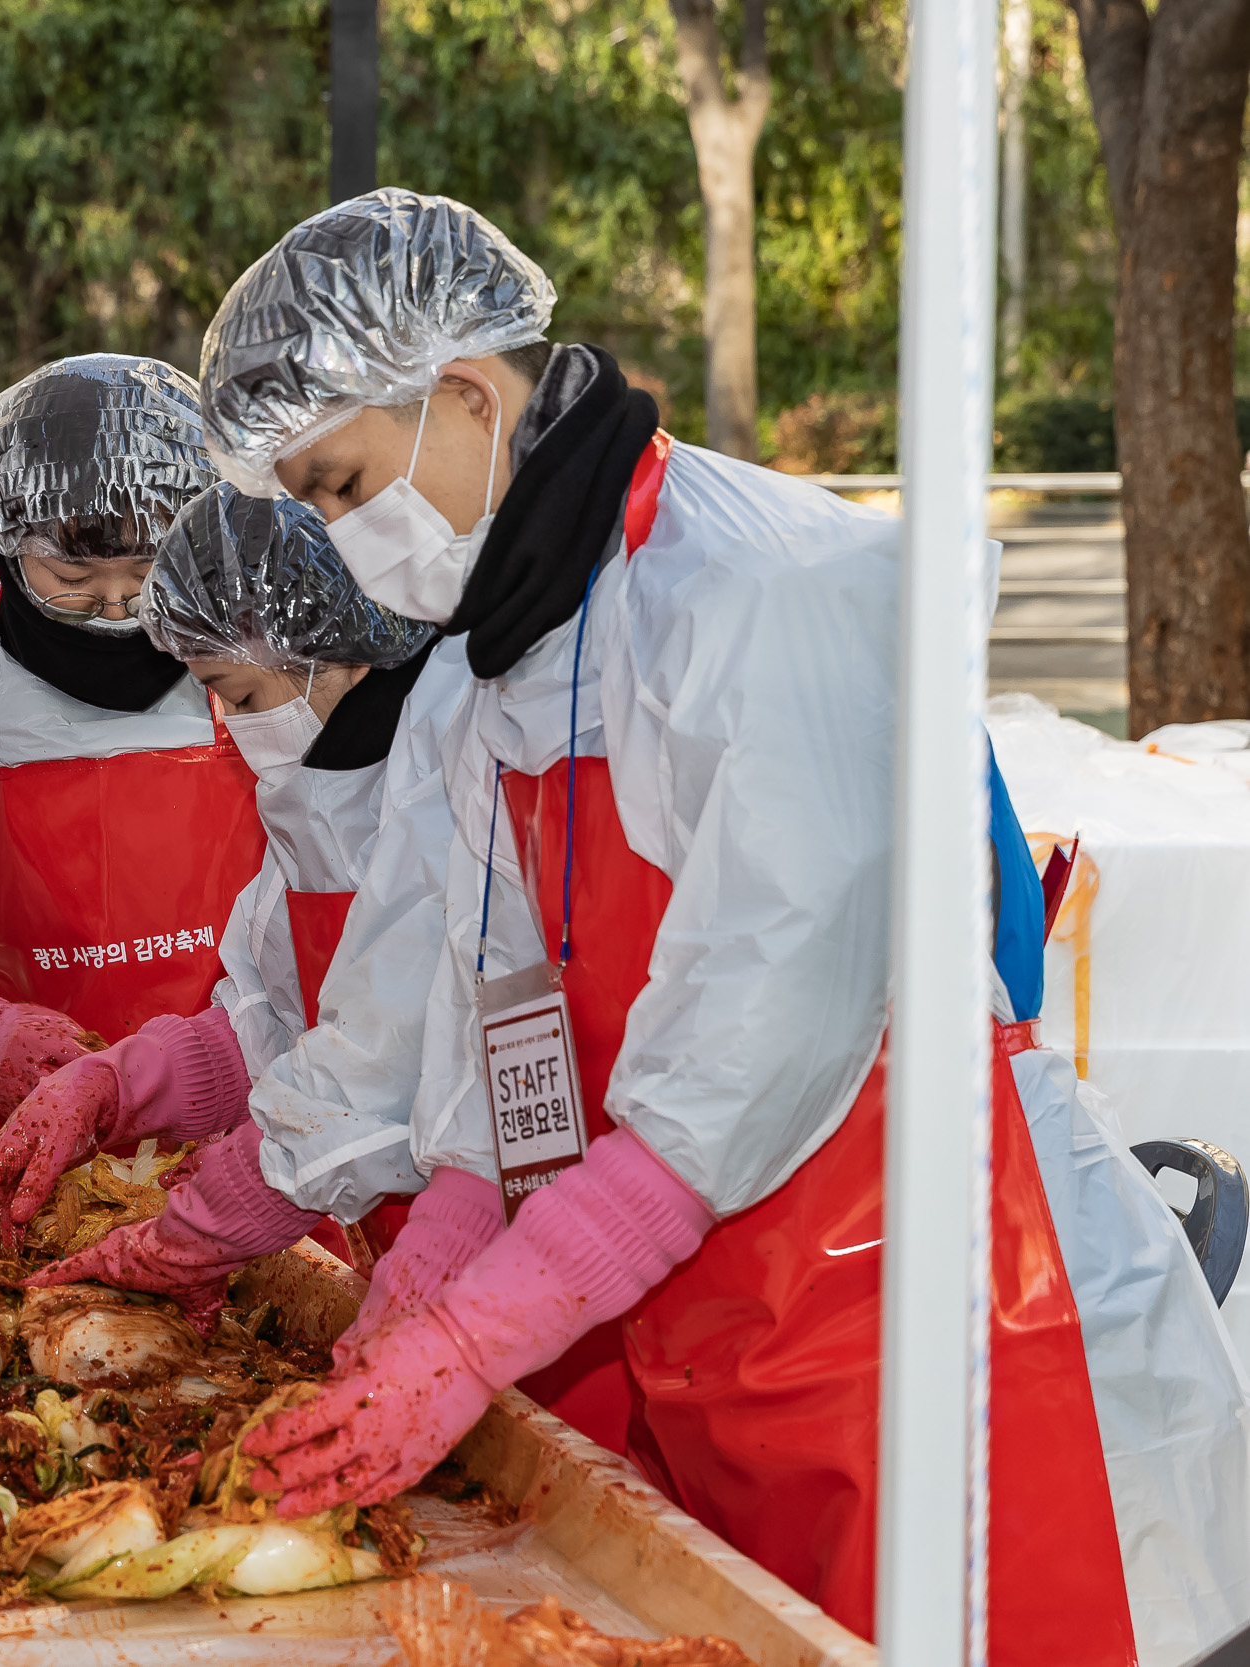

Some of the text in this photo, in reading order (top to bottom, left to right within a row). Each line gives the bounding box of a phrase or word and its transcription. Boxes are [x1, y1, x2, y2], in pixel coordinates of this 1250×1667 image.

[32, 925, 215, 970] 광진 사랑의 김장축제
[498, 1056, 558, 1103] STAFF
[500, 1096, 570, 1144] 진행요원
